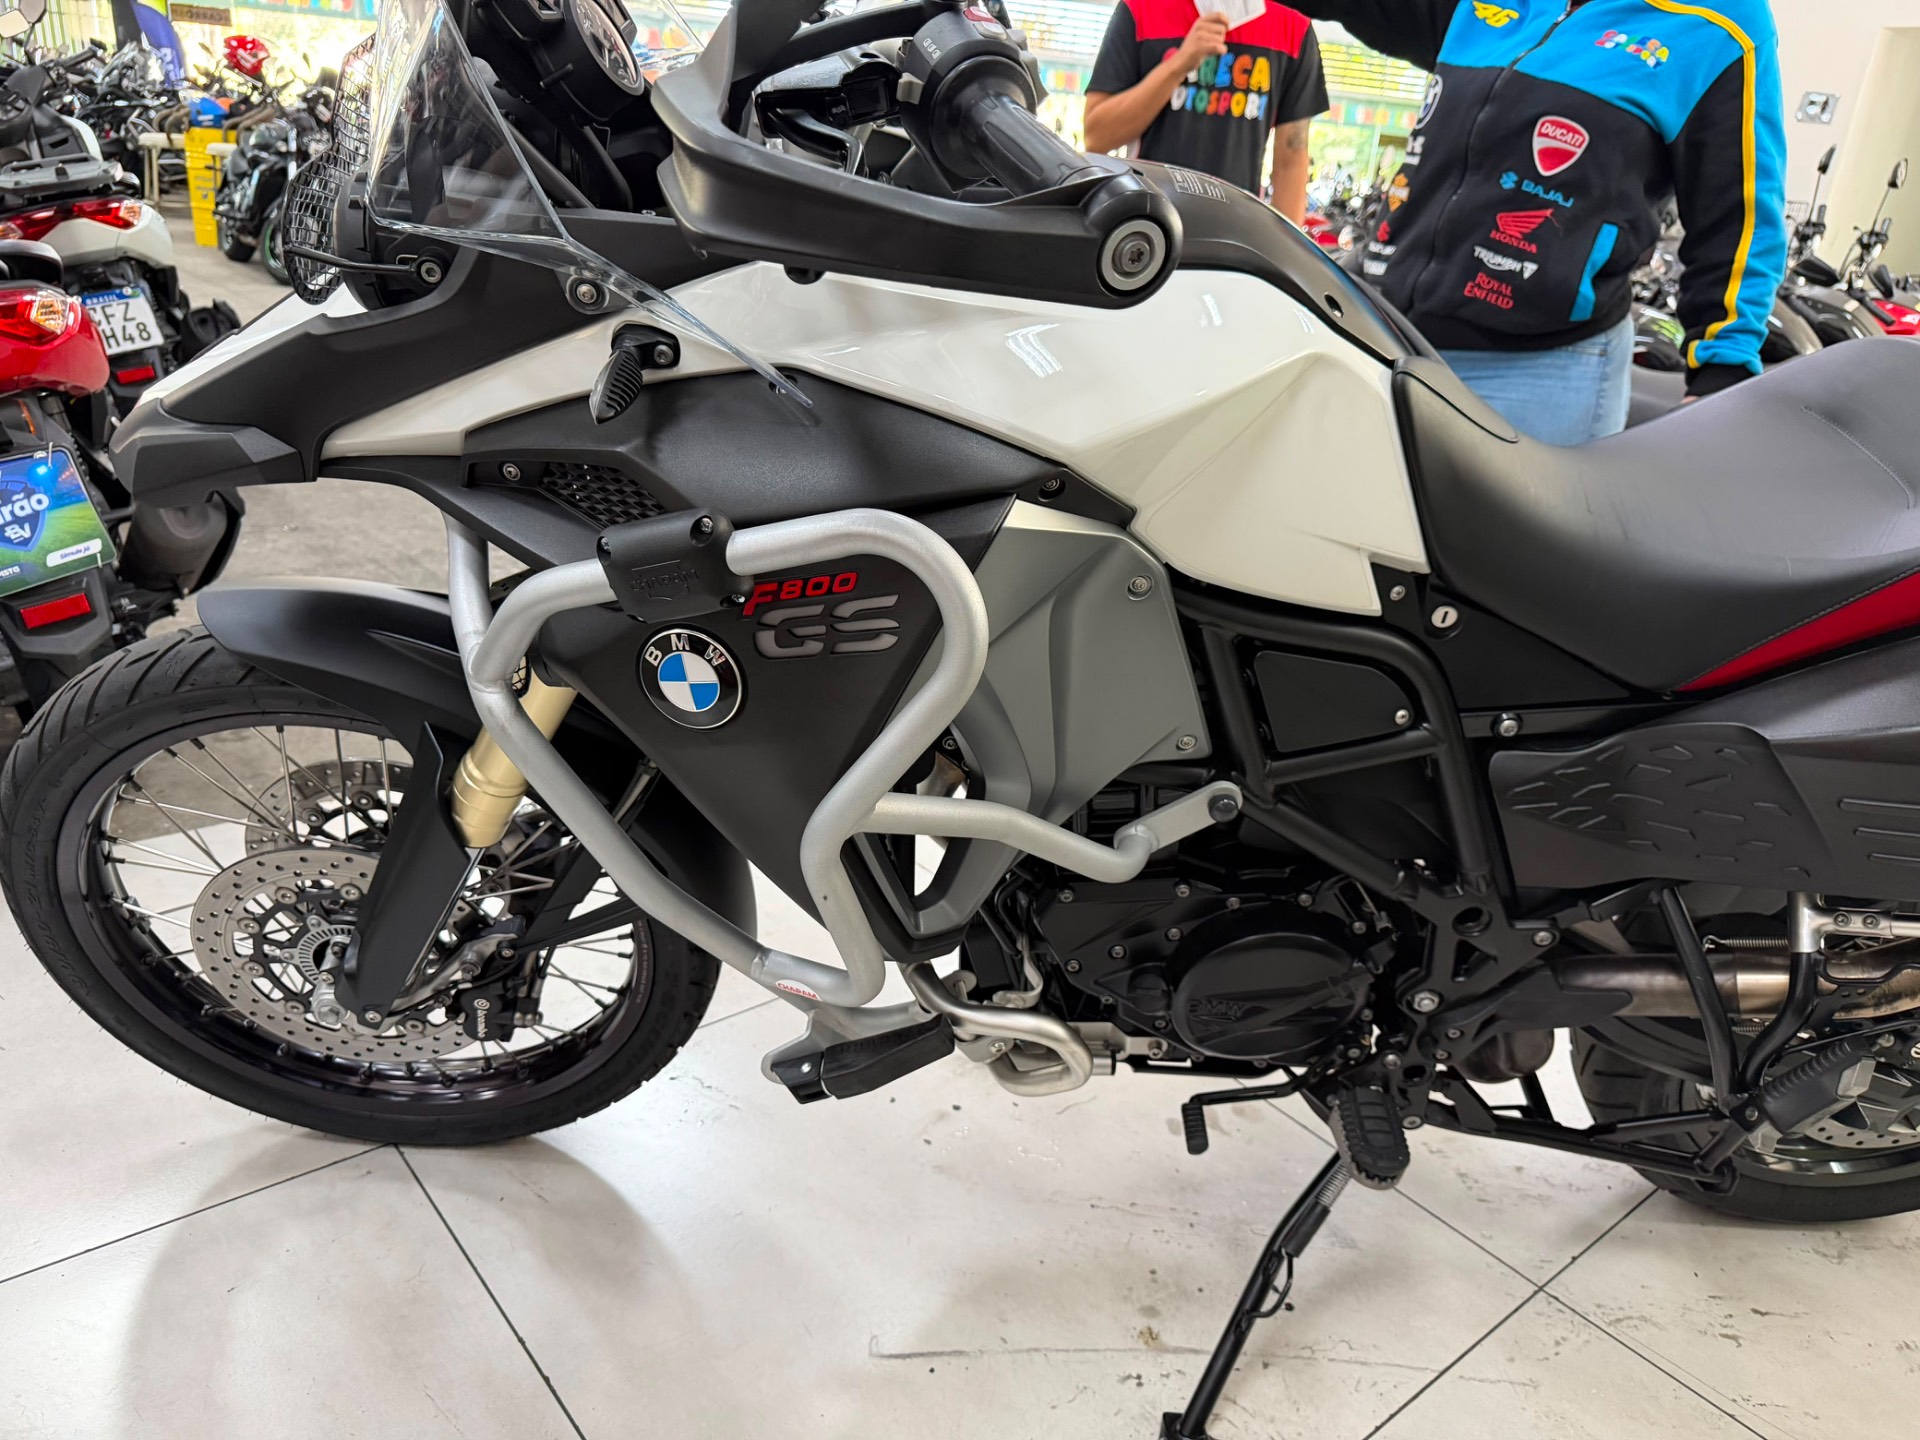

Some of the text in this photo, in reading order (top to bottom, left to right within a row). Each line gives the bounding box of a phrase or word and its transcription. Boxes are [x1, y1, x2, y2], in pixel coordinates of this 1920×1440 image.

[1162, 47, 1271, 93] RECA
[1170, 84, 1268, 121] OTOSPORT
[1540, 122, 1585, 147] DUCATI
[1521, 179, 1575, 208] BAJAJ
[1489, 230, 1538, 253] HONDA
[1474, 245, 1523, 273] TRIUMPH
[1475, 272, 1513, 297] ROYAL
[101, 322, 152, 350] H48
[0, 491, 50, 524] rão
[742, 572, 858, 617] F800
[754, 594, 900, 660] GS
[644, 633, 726, 668] BMW
[476, 1009, 490, 1038] brembo
